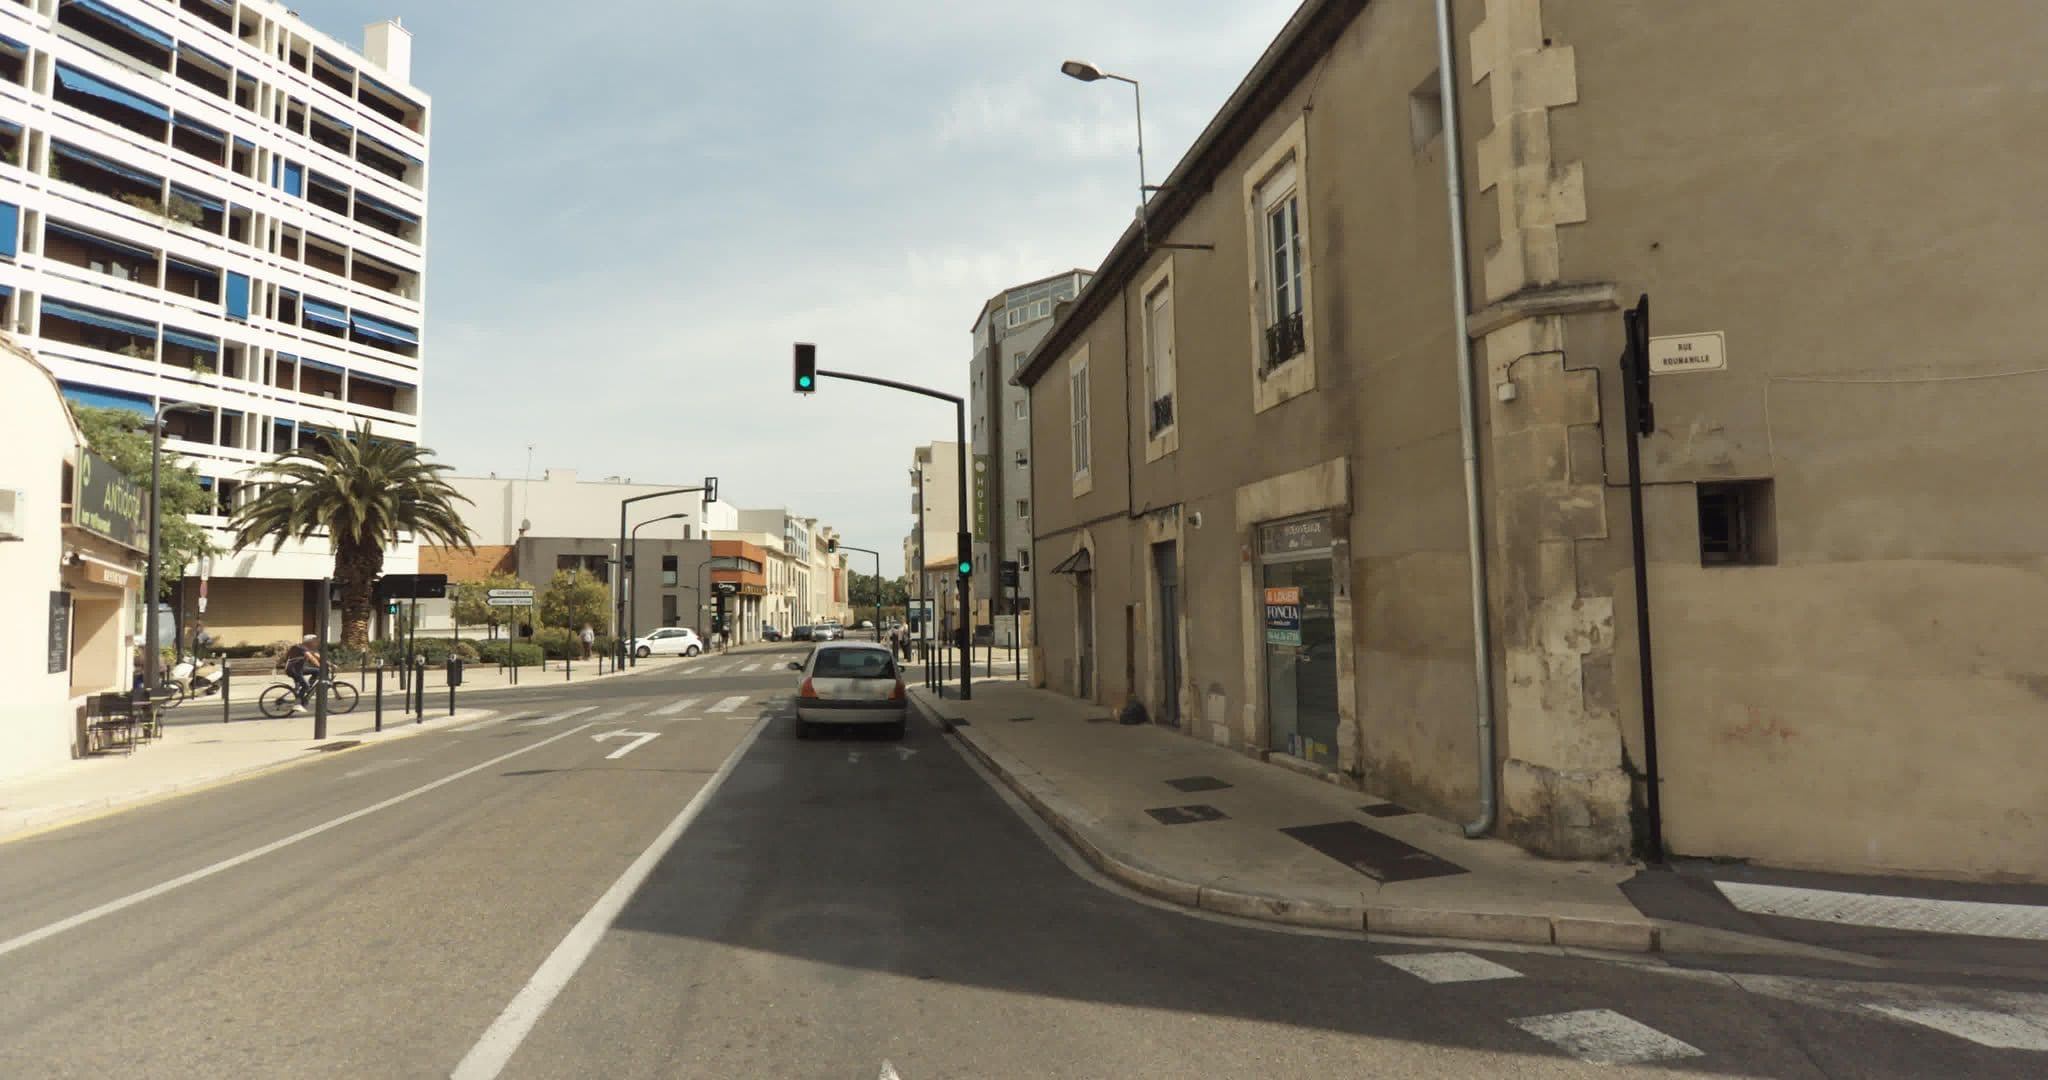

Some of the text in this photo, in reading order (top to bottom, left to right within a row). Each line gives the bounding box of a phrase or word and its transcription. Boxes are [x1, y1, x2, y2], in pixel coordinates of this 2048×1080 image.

[1678, 343, 1692, 351] RUE
[1663, 354, 1709, 365] ROUMANILLE
[977, 478, 985, 535] HOTEL
[1266, 605, 1298, 619] FONCIA
